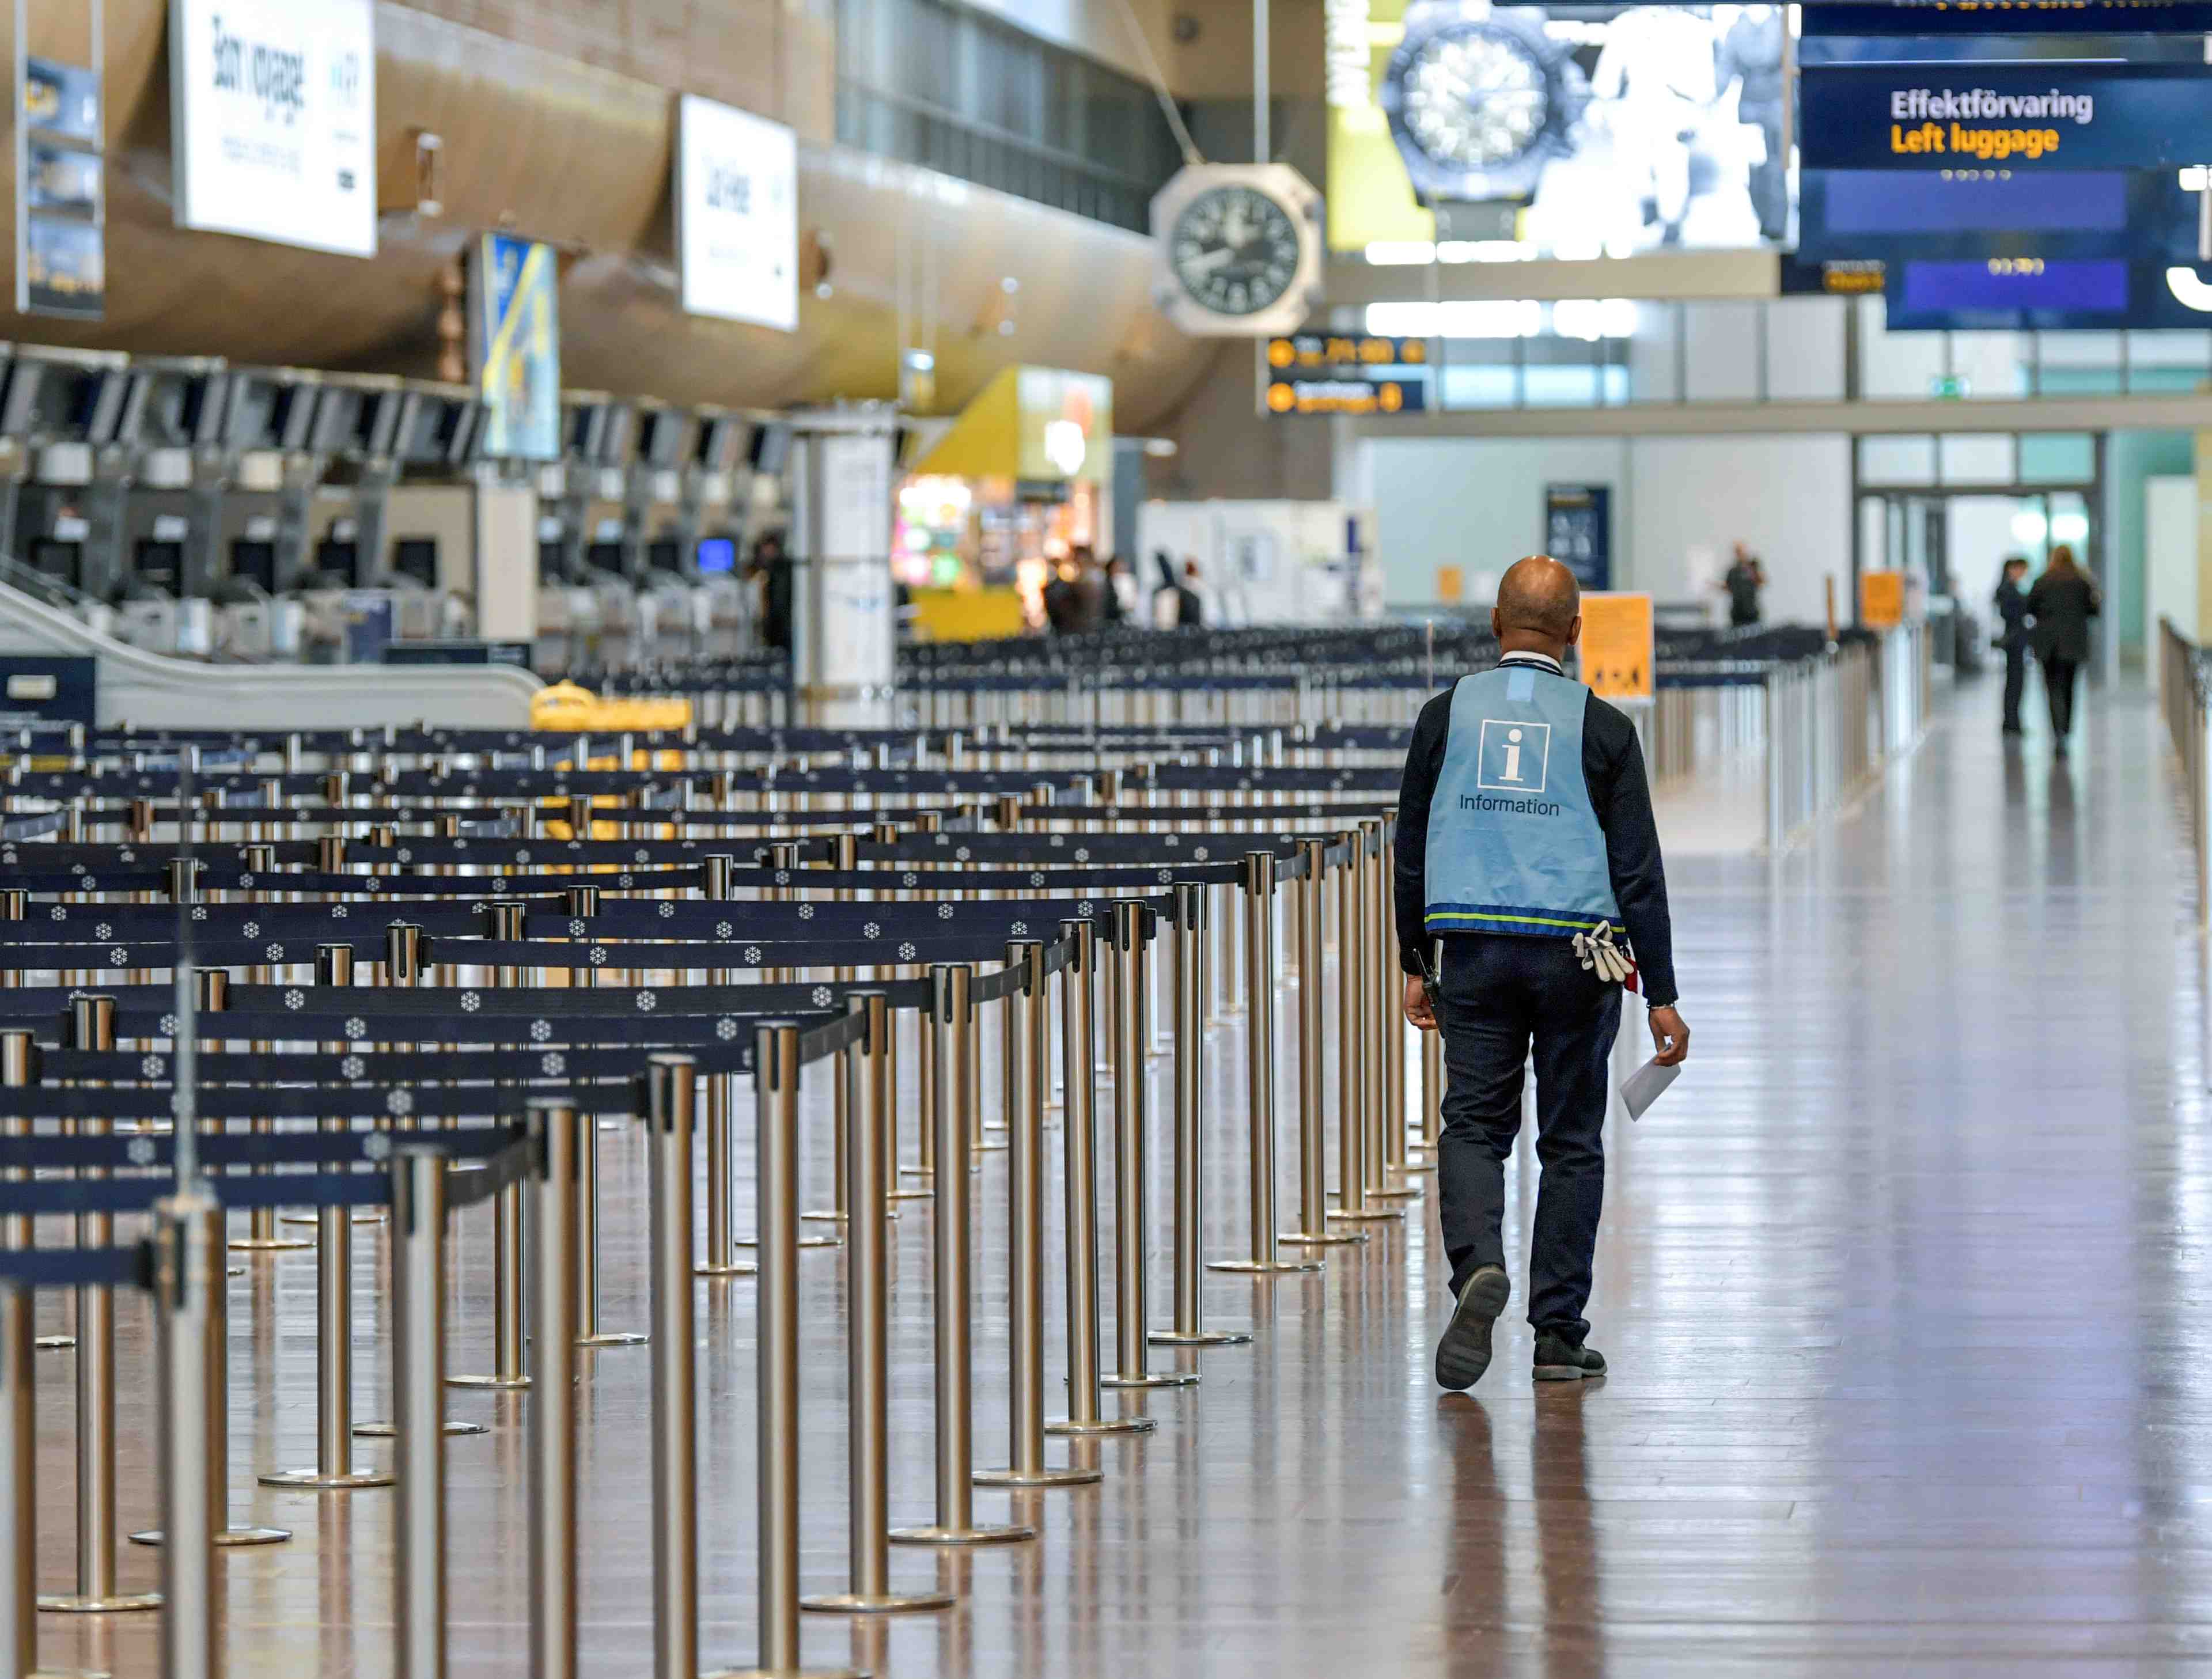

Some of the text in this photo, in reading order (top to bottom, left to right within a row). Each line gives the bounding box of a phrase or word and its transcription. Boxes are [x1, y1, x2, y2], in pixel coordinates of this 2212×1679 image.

[1891, 88, 2094, 124] Effektförvaring
[1891, 122, 2059, 160] Left luggage
[1460, 794, 1559, 816] Information
